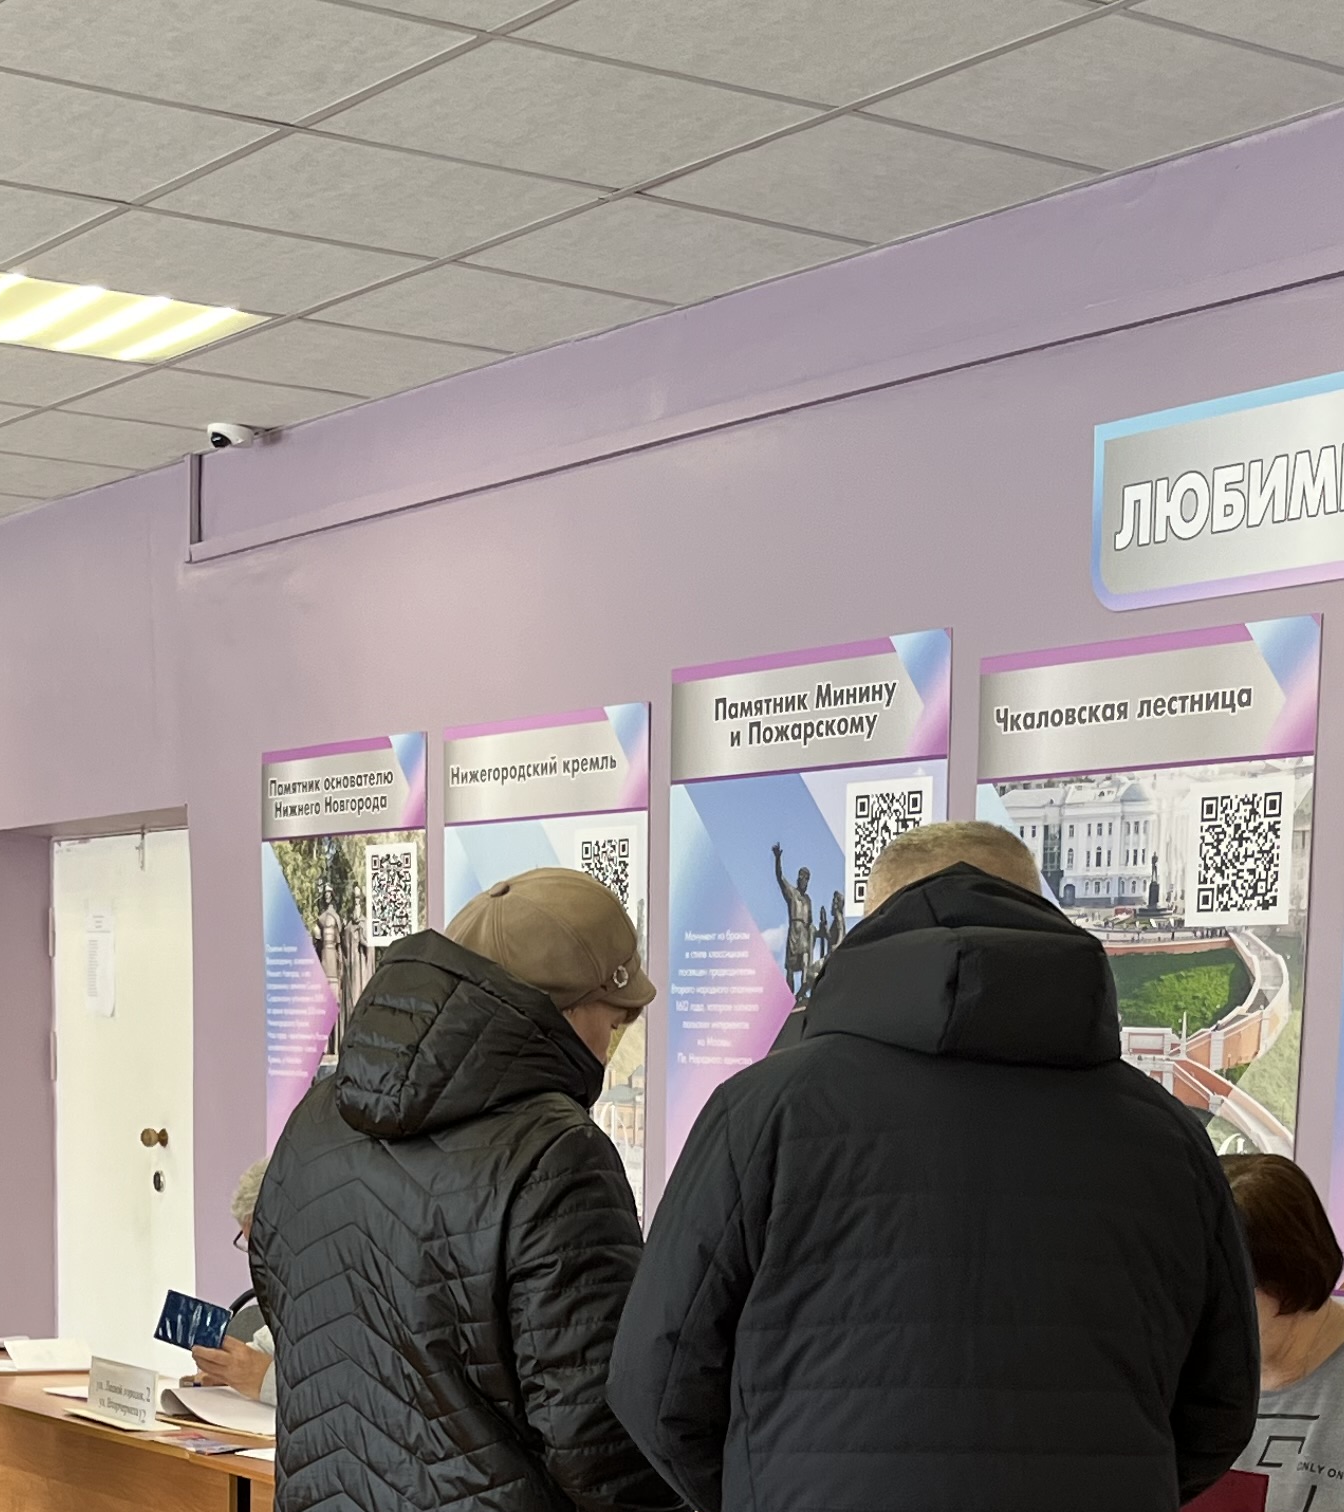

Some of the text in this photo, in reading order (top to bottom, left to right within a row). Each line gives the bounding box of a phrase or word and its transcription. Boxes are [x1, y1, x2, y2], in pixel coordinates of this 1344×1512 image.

[714, 681, 897, 721] Памятник Минину
[995, 687, 1253, 733] Чкаловская лестница
[730, 713, 878, 747] и Пожарскому
[269, 770, 394, 797] Памятник основателю
[450, 754, 617, 785] Нижегородский кремль
[274, 795, 388, 818] Нижнего Новгорода
